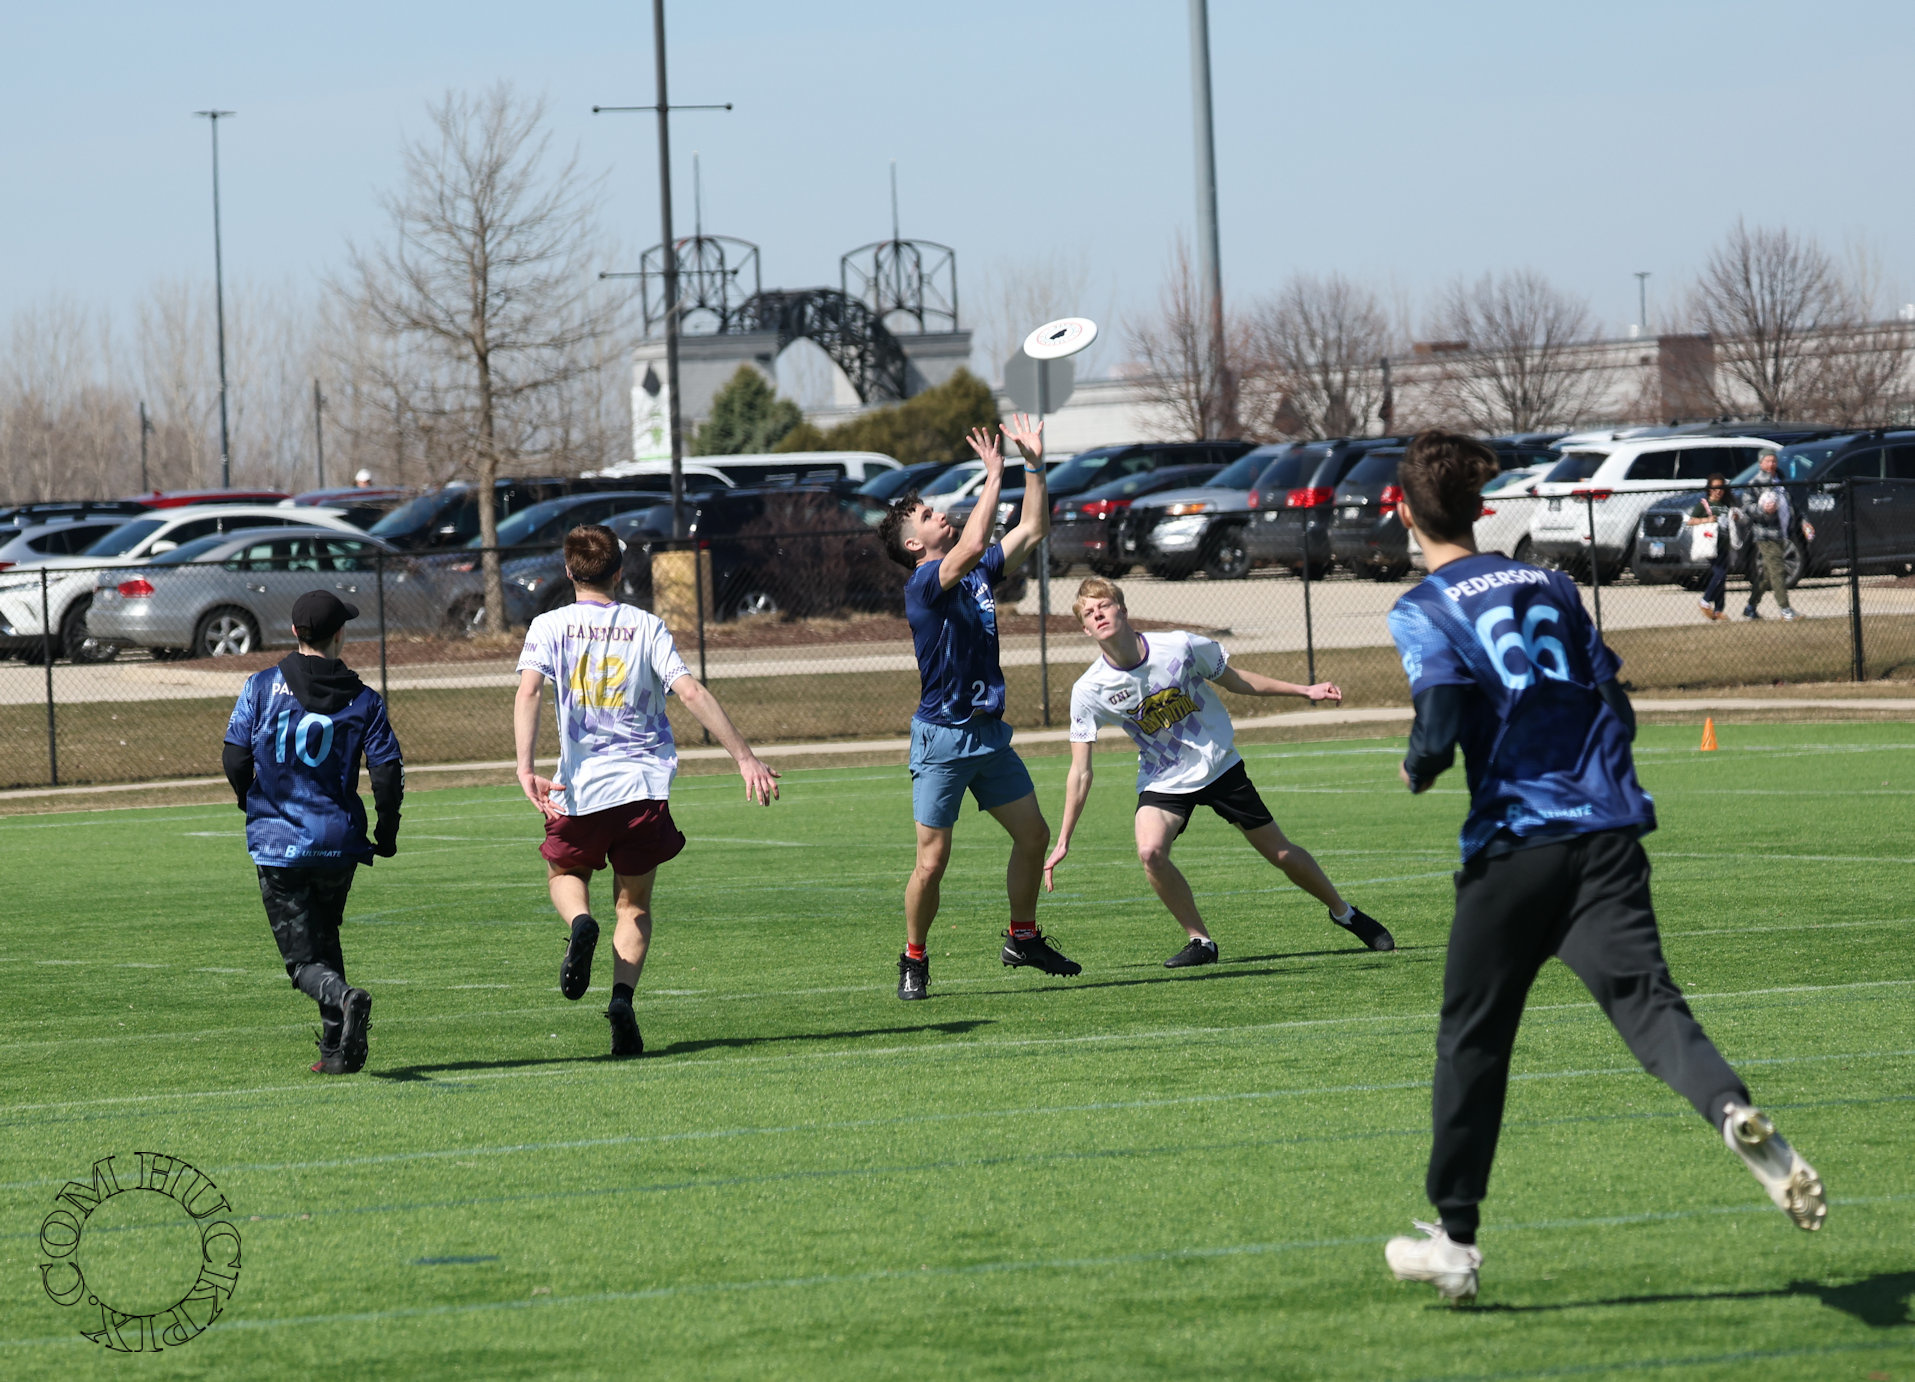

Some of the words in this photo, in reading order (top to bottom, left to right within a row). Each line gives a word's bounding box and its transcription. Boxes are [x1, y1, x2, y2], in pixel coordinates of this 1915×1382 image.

[1443, 569, 1550, 602] PEDERSON
[567, 624, 636, 641] CANNON
[1475, 604, 1570, 690] 66
[570, 654, 626, 709] 42
[971, 679, 988, 707] 2
[1109, 689, 1131, 705] UNI
[275, 709, 334, 768] 10
